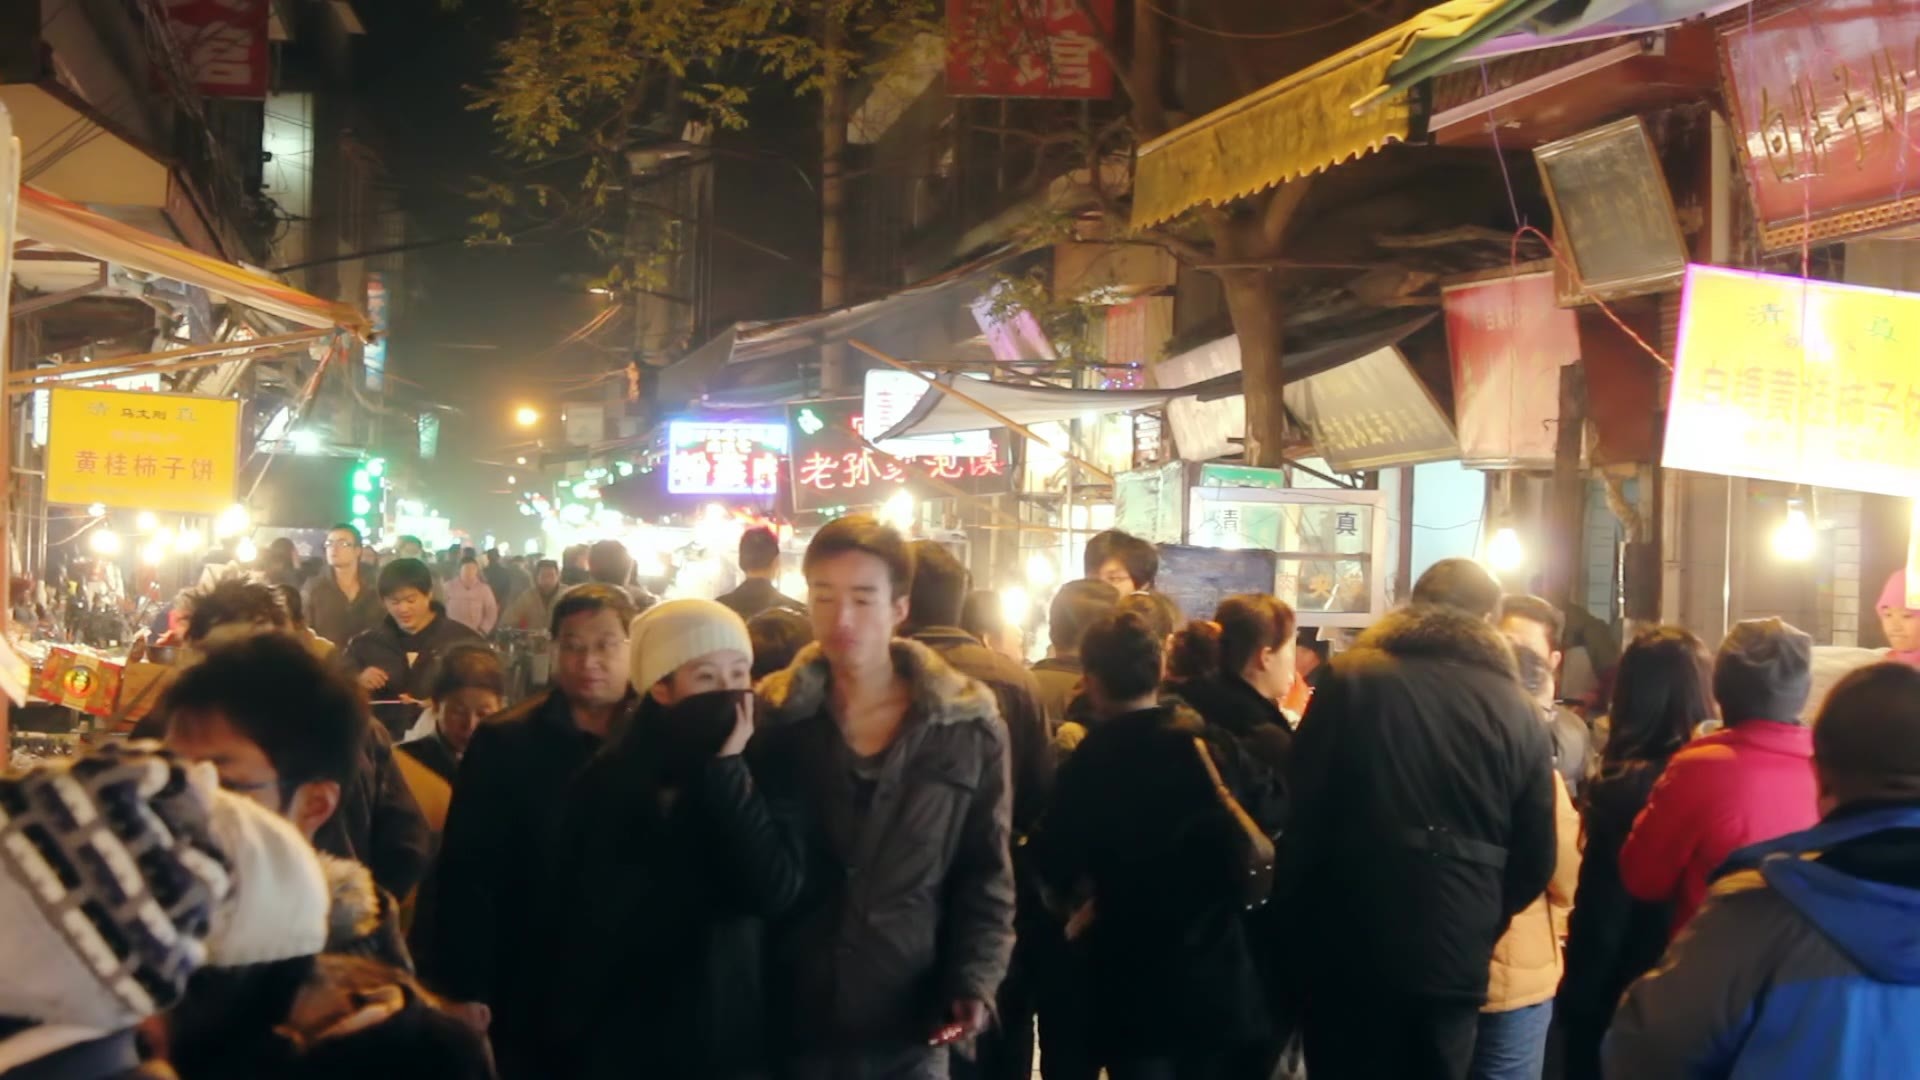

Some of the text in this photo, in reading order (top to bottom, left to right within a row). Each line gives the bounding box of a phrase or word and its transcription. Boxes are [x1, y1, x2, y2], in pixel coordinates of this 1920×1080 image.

[75, 450, 215, 481] 黄桂柿子饼
[799, 443, 1004, 489] 老孙泡馍
[1335, 511, 1357, 536] 真
